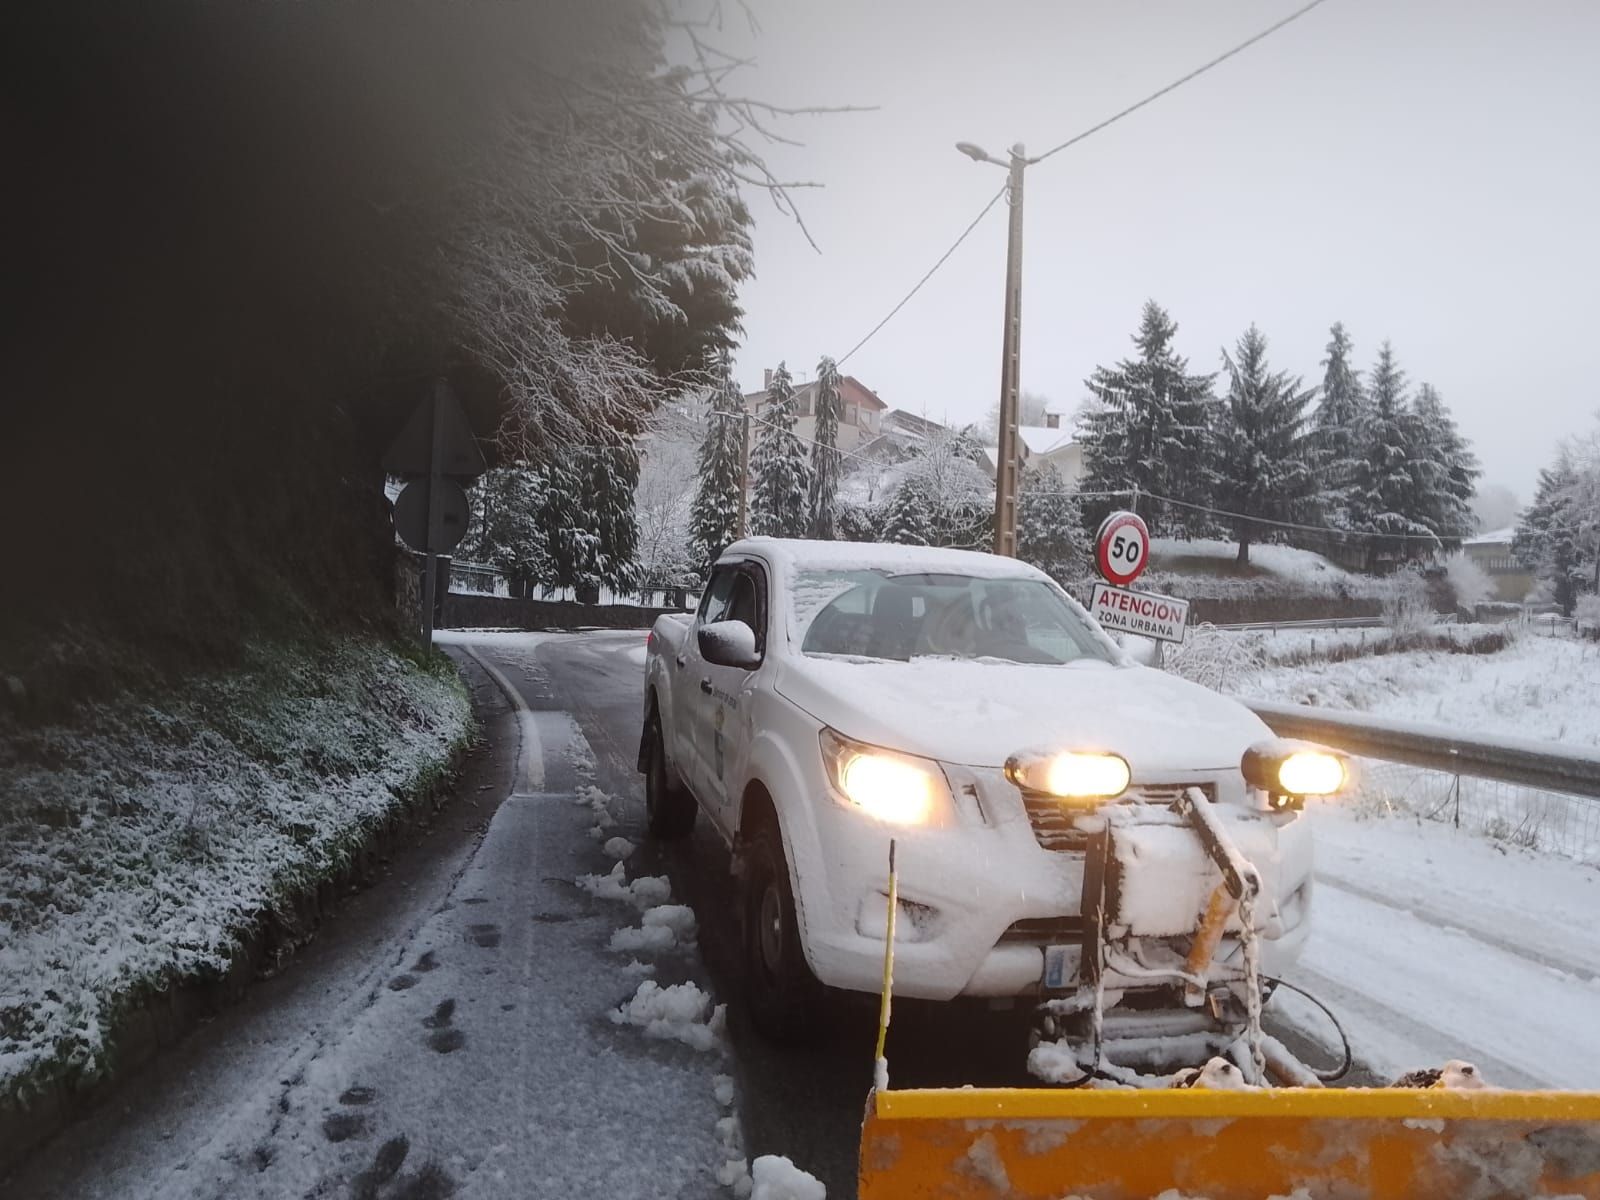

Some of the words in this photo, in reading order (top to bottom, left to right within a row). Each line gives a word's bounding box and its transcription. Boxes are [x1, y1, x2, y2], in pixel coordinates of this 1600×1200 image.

[1112, 535, 1139, 563] 50
[1098, 610, 1127, 627] ZONA
[1130, 618, 1173, 636] URBANA
